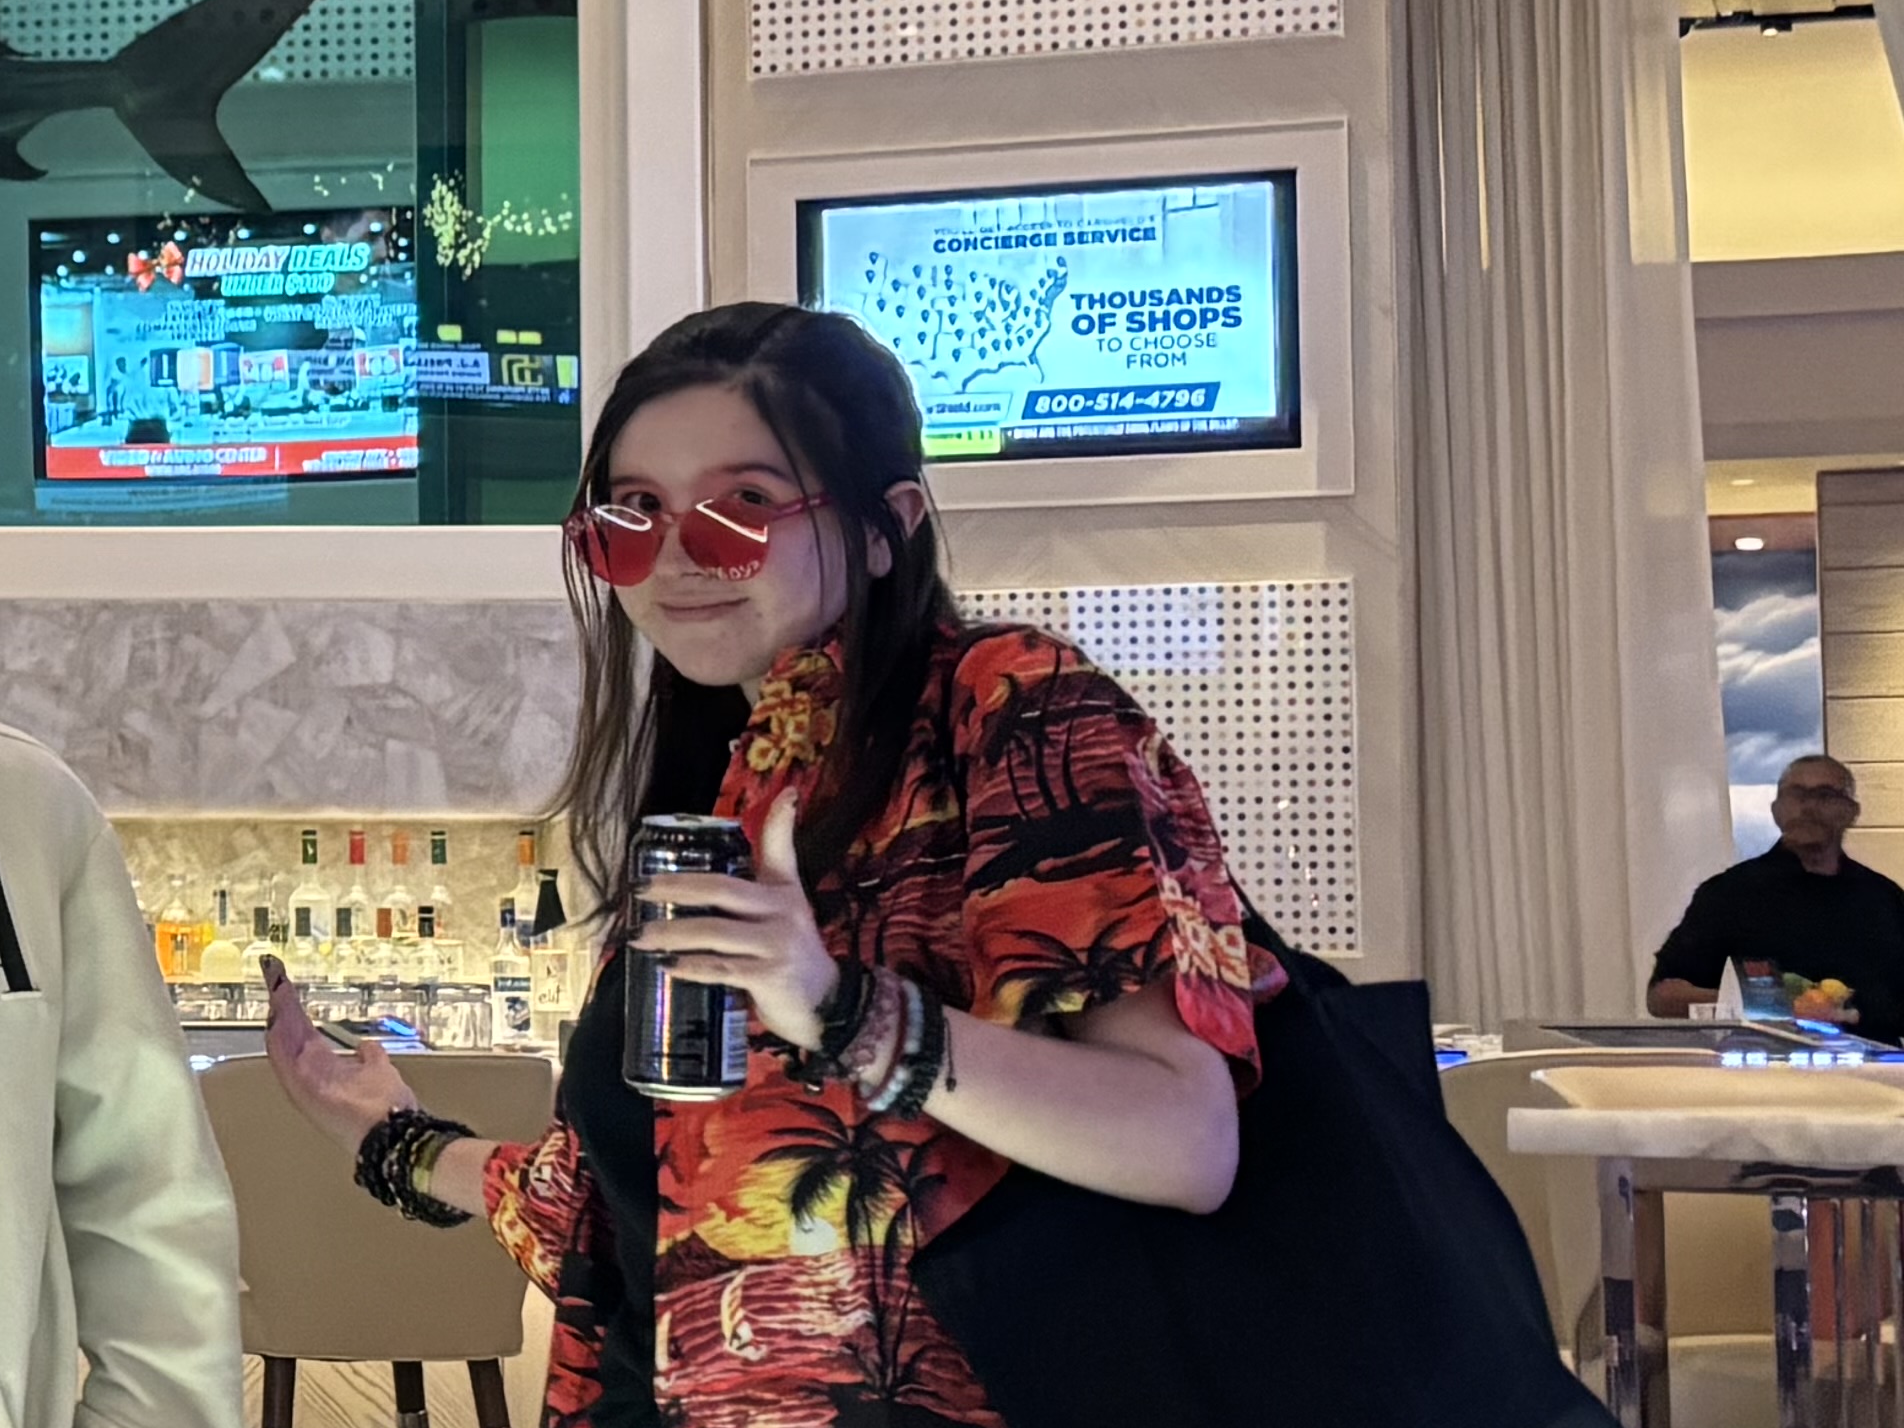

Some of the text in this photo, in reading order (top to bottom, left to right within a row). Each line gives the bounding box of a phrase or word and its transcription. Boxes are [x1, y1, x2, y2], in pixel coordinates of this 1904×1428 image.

[933, 227, 1156, 253] CONCIERGE SERVICE
[186, 242, 370, 277] HOLIDAY DEALS
[1070, 285, 1242, 310] THOUSANDS
[1071, 306, 1243, 335] OF SHOPS
[1096, 333, 1217, 352] TO CHOOSE
[1126, 352, 1187, 369] FROM
[1034, 388, 1206, 413] 800-514-4796
